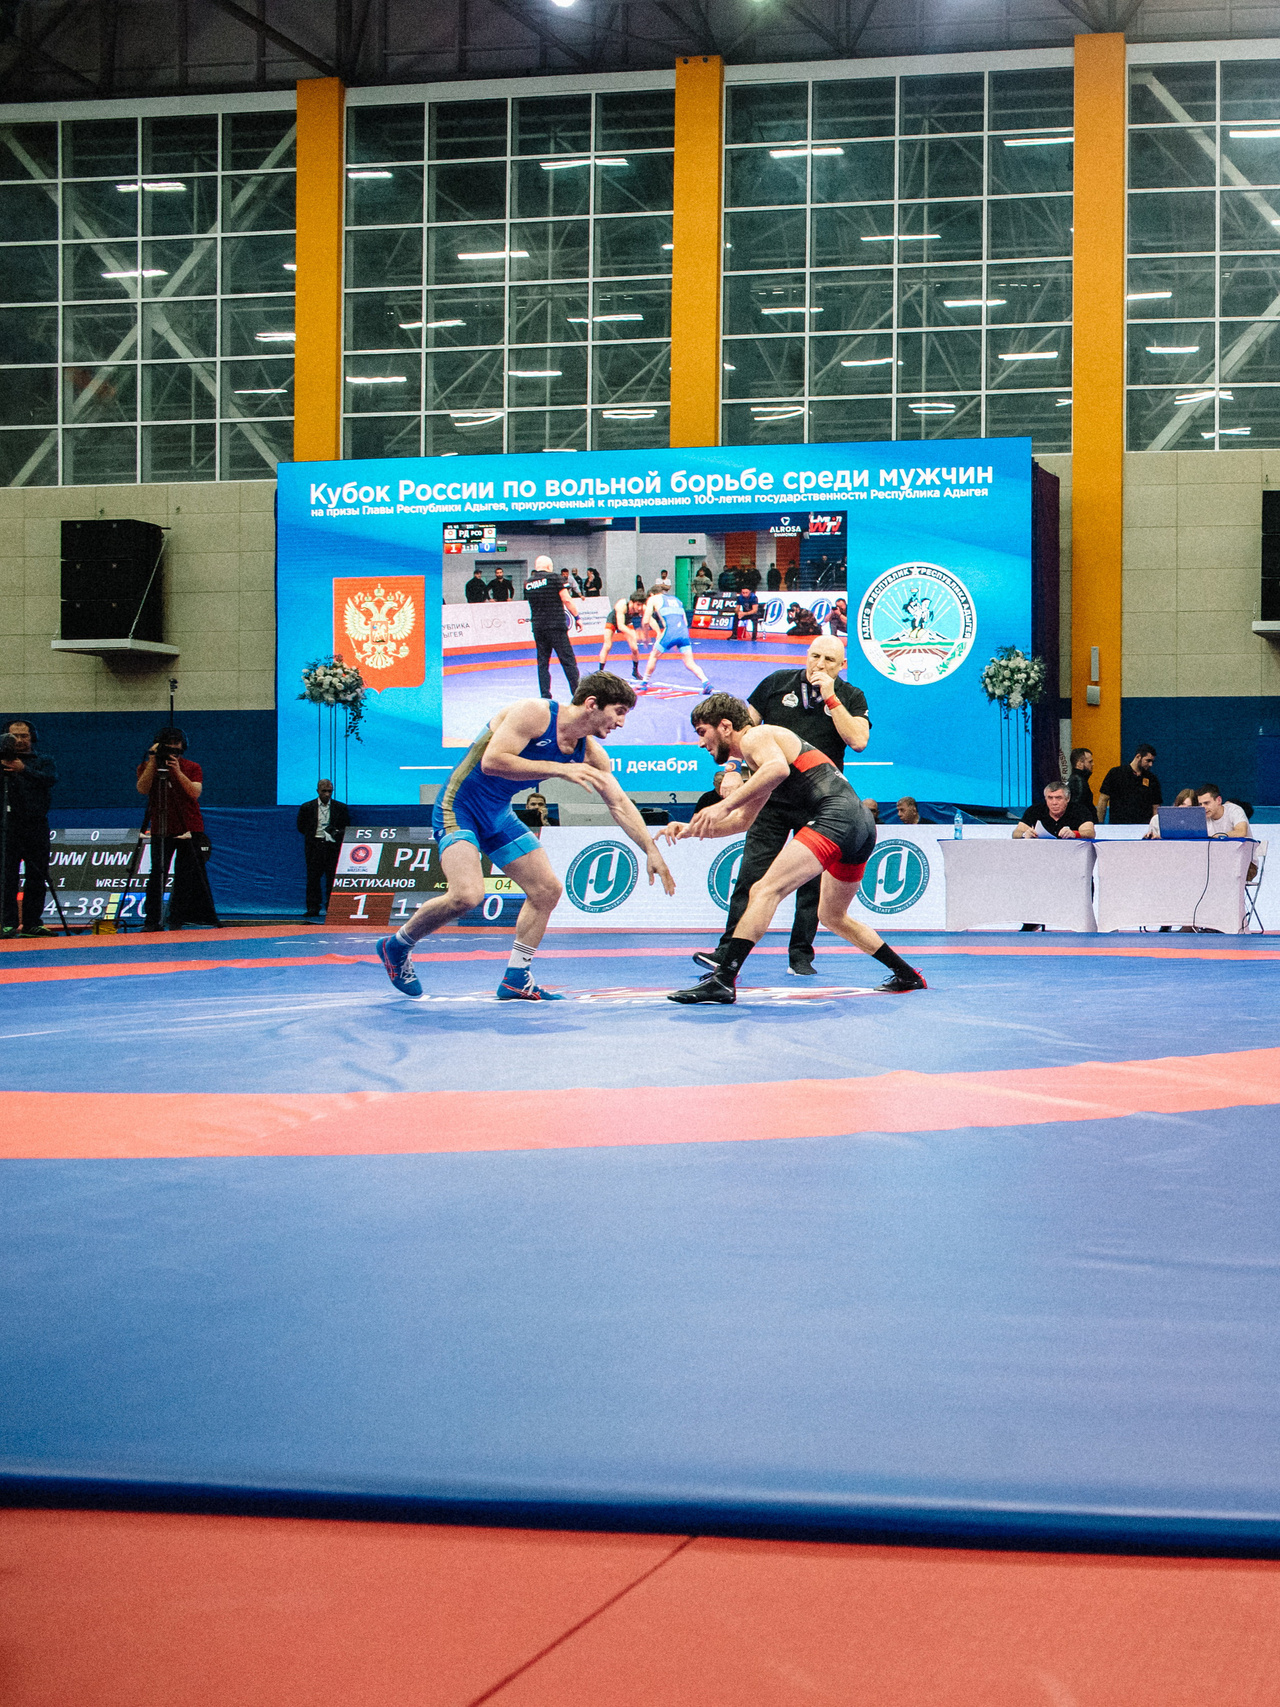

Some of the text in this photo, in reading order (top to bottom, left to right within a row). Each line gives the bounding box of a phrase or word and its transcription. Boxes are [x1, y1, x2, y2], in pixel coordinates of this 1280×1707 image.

[310, 466, 993, 508] Кубок России по вольной борьбе среди мужчин
[311, 487, 988, 518] на призы Главы Республики Адыгея, приуроченный к празднованию 100-летия государственности Республика Адыгея
[458, 530, 470, 538] РД
[450, 544, 457, 553] 1
[484, 543, 490, 551] 0
[525, 579, 548, 590] СУДЬЯ
[711, 599, 724, 609] РД
[862, 567, 973, 639] АДЫГЭ РЕСПУБЛИК РЕСПУБЛИКА АДЫГЕЯ
[698, 616, 730, 627] 1 1:09
[609, 757, 698, 774] 11 декабря
[669, 793, 678, 803] 3
[91, 830, 100, 841] 0
[356, 829, 372, 839] FS
[380, 828, 397, 839] 65
[91, 851, 133, 866] UWW
[393, 847, 432, 872] РД
[57, 877, 66, 887] 1
[95, 877, 175, 888] WRESTLE 2
[332, 878, 416, 889] МЕХТИХАНОВ
[494, 879, 512, 890] 04
[349, 894, 369, 919] 1
[483, 894, 504, 920] 0
